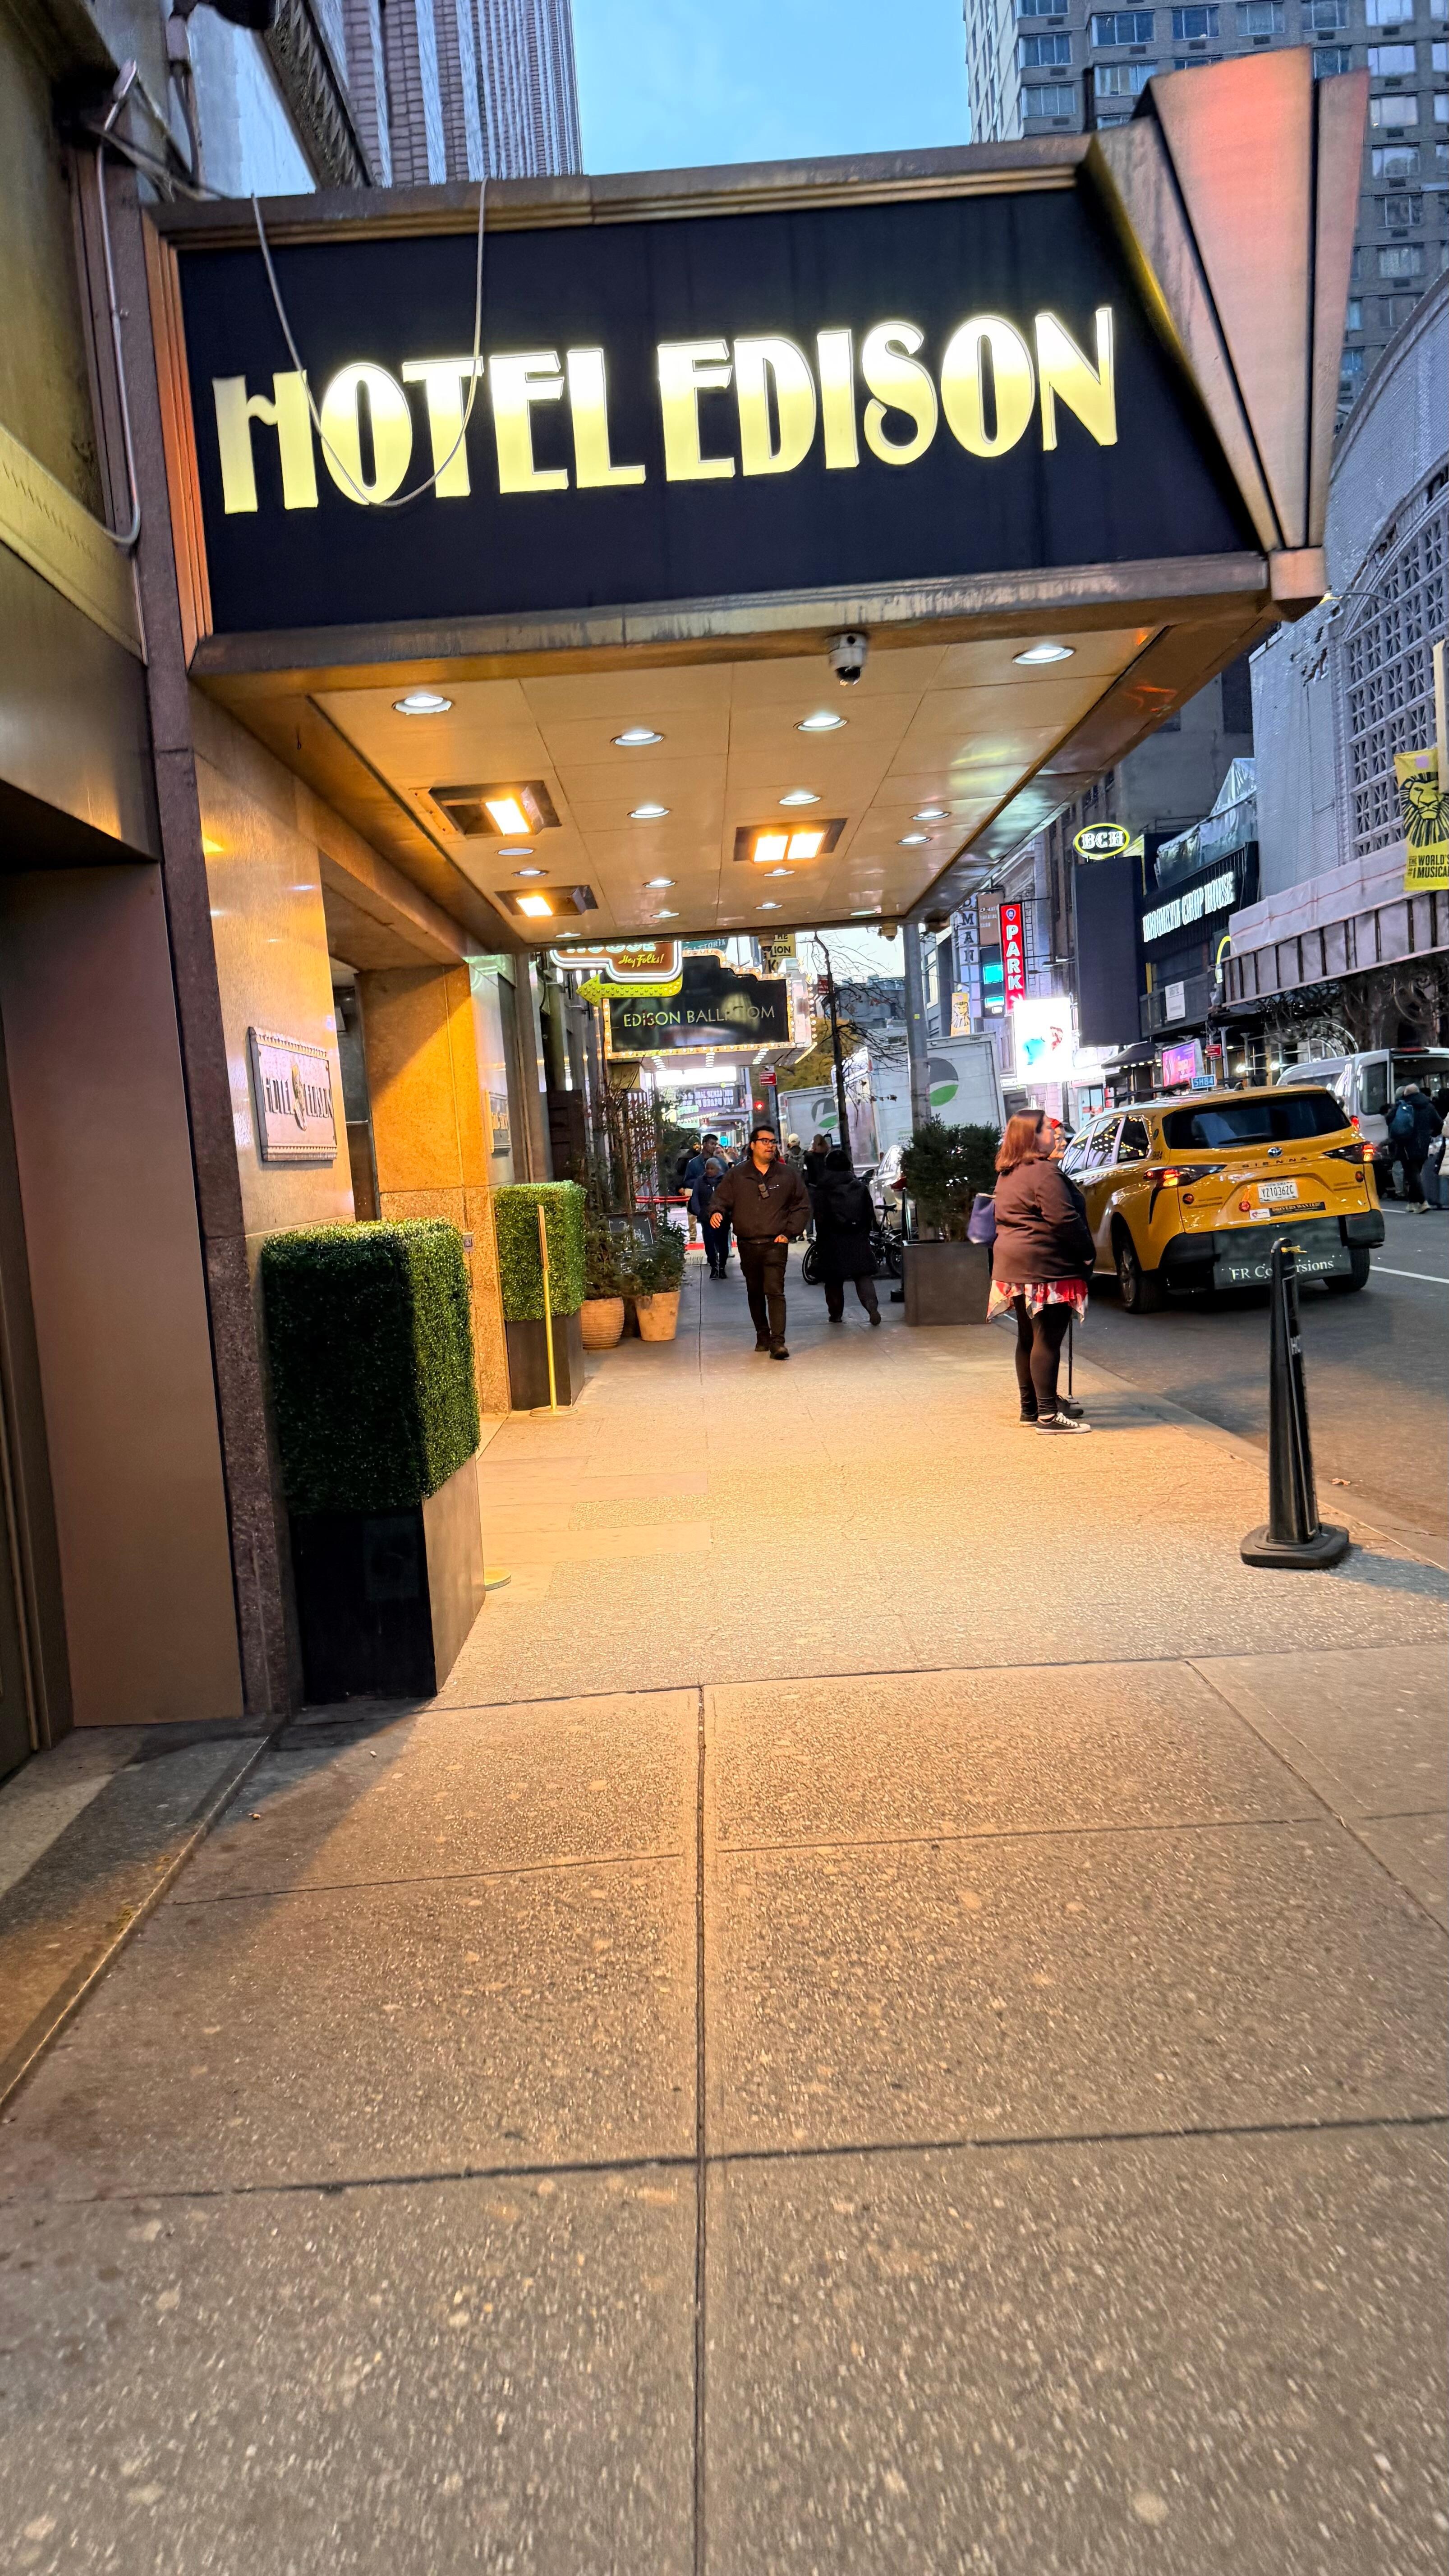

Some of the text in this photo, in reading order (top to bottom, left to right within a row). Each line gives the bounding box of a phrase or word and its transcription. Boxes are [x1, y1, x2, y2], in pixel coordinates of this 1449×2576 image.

[213, 307, 1119, 513] HOTEL EDISON
[1081, 831, 1124, 849] BCH
[618, 953, 665, 968] Hey Folks!
[1006, 925, 1023, 990] PARK
[624, 1011, 681, 1027] EDISON
[1232, 1260, 1334, 1280] FR Corsions
